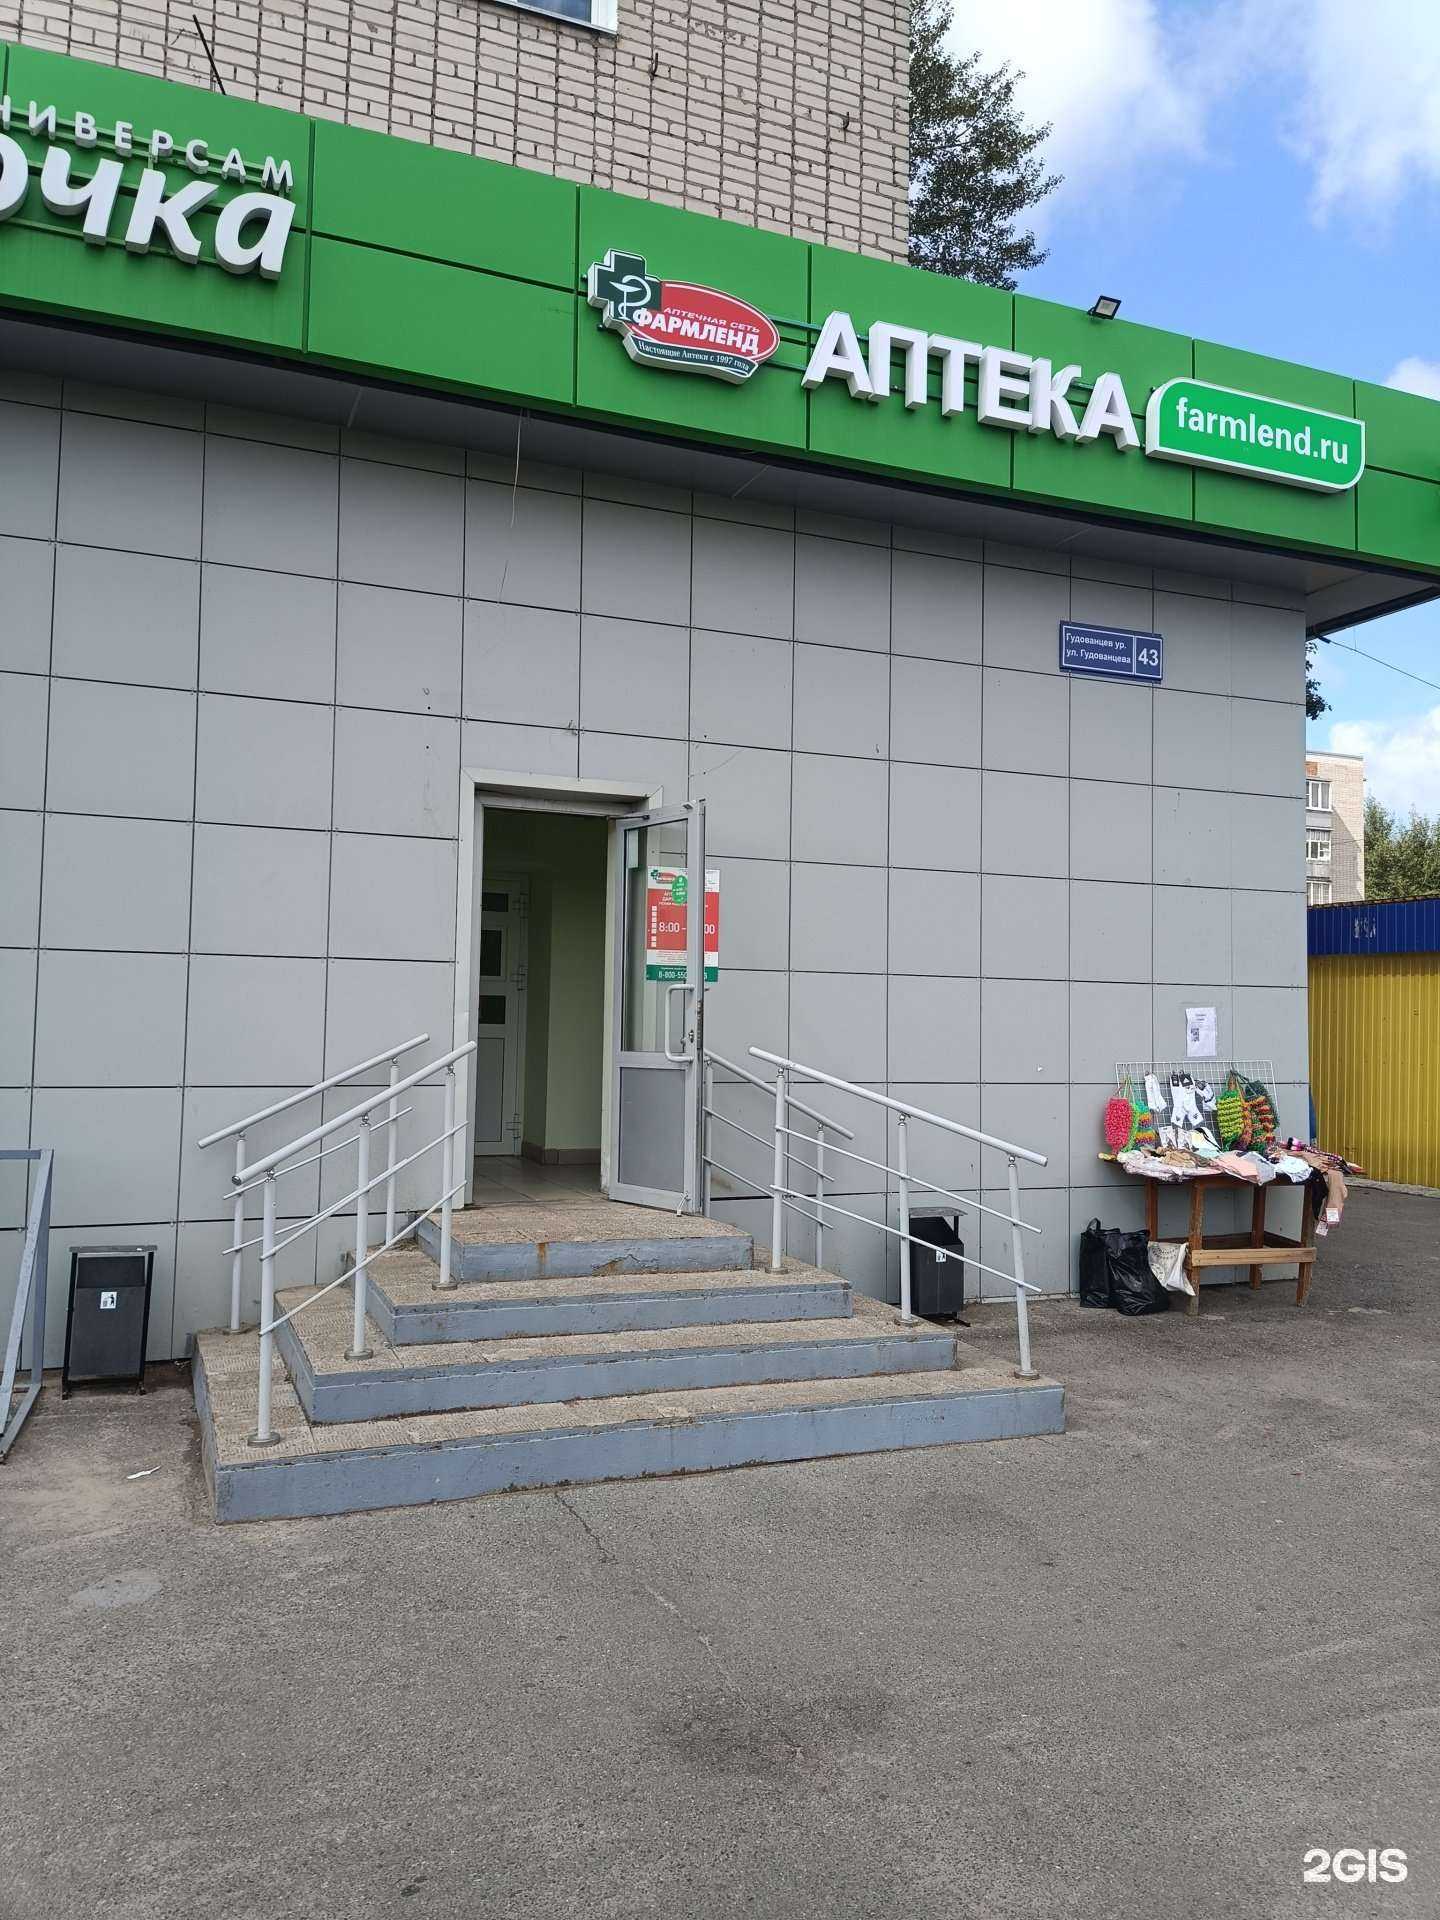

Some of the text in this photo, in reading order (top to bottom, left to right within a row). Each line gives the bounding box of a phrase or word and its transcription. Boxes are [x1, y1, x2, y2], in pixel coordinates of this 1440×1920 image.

[663, 307, 760, 333] АПТЕЧНАЯ СЕТЬ
[632, 307, 760, 355] ФАРМЛЕНД
[681, 350, 708, 361] Аптеки
[716, 355, 732, 365] 1997
[733, 360, 750, 371] года
[801, 310, 1140, 453] АПТЕКА
[1175, 396, 1349, 465] farmlend.ru
[1066, 632, 1127, 650] Гудованцев ур.
[1066, 648, 1131, 664] ул. Гудованцева
[1138, 647, 1159, 666] 43
[658, 921, 680, 933] 8:00
